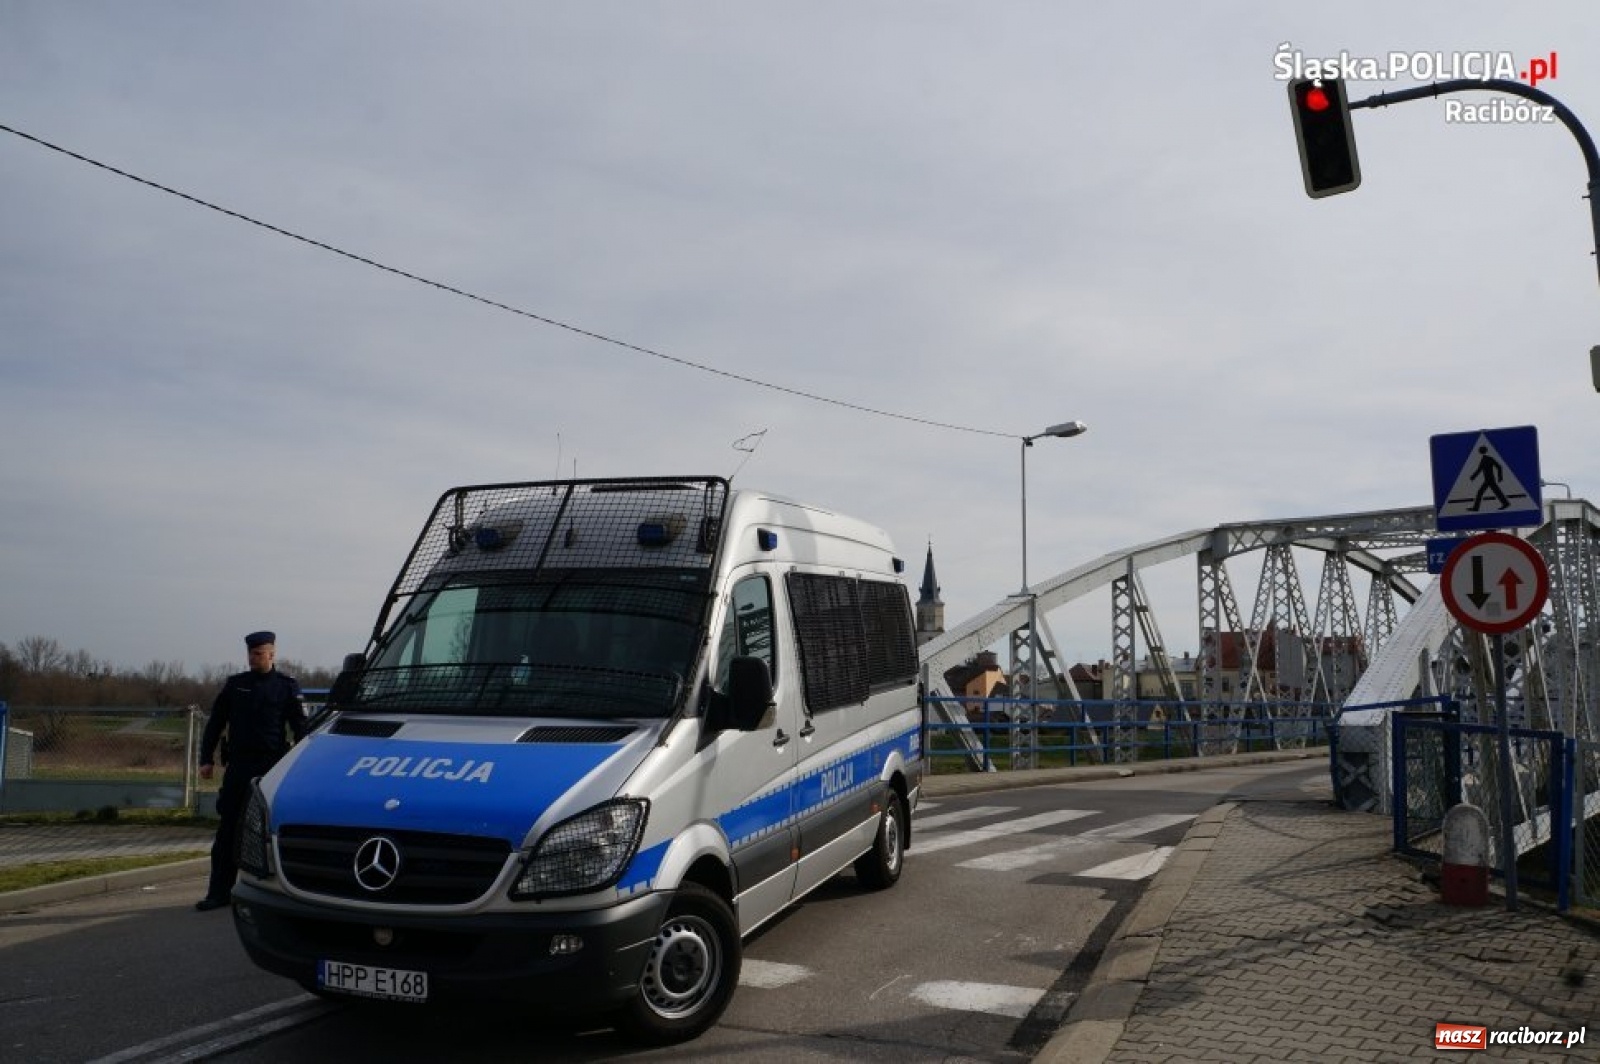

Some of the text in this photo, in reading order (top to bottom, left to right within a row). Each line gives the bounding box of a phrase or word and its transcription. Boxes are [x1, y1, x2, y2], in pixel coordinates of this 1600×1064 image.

[346, 756, 495, 783] POLICJA
[821, 761, 854, 799] POLICJA
[327, 962, 368, 989] HPP
[375, 969, 425, 996] E168
